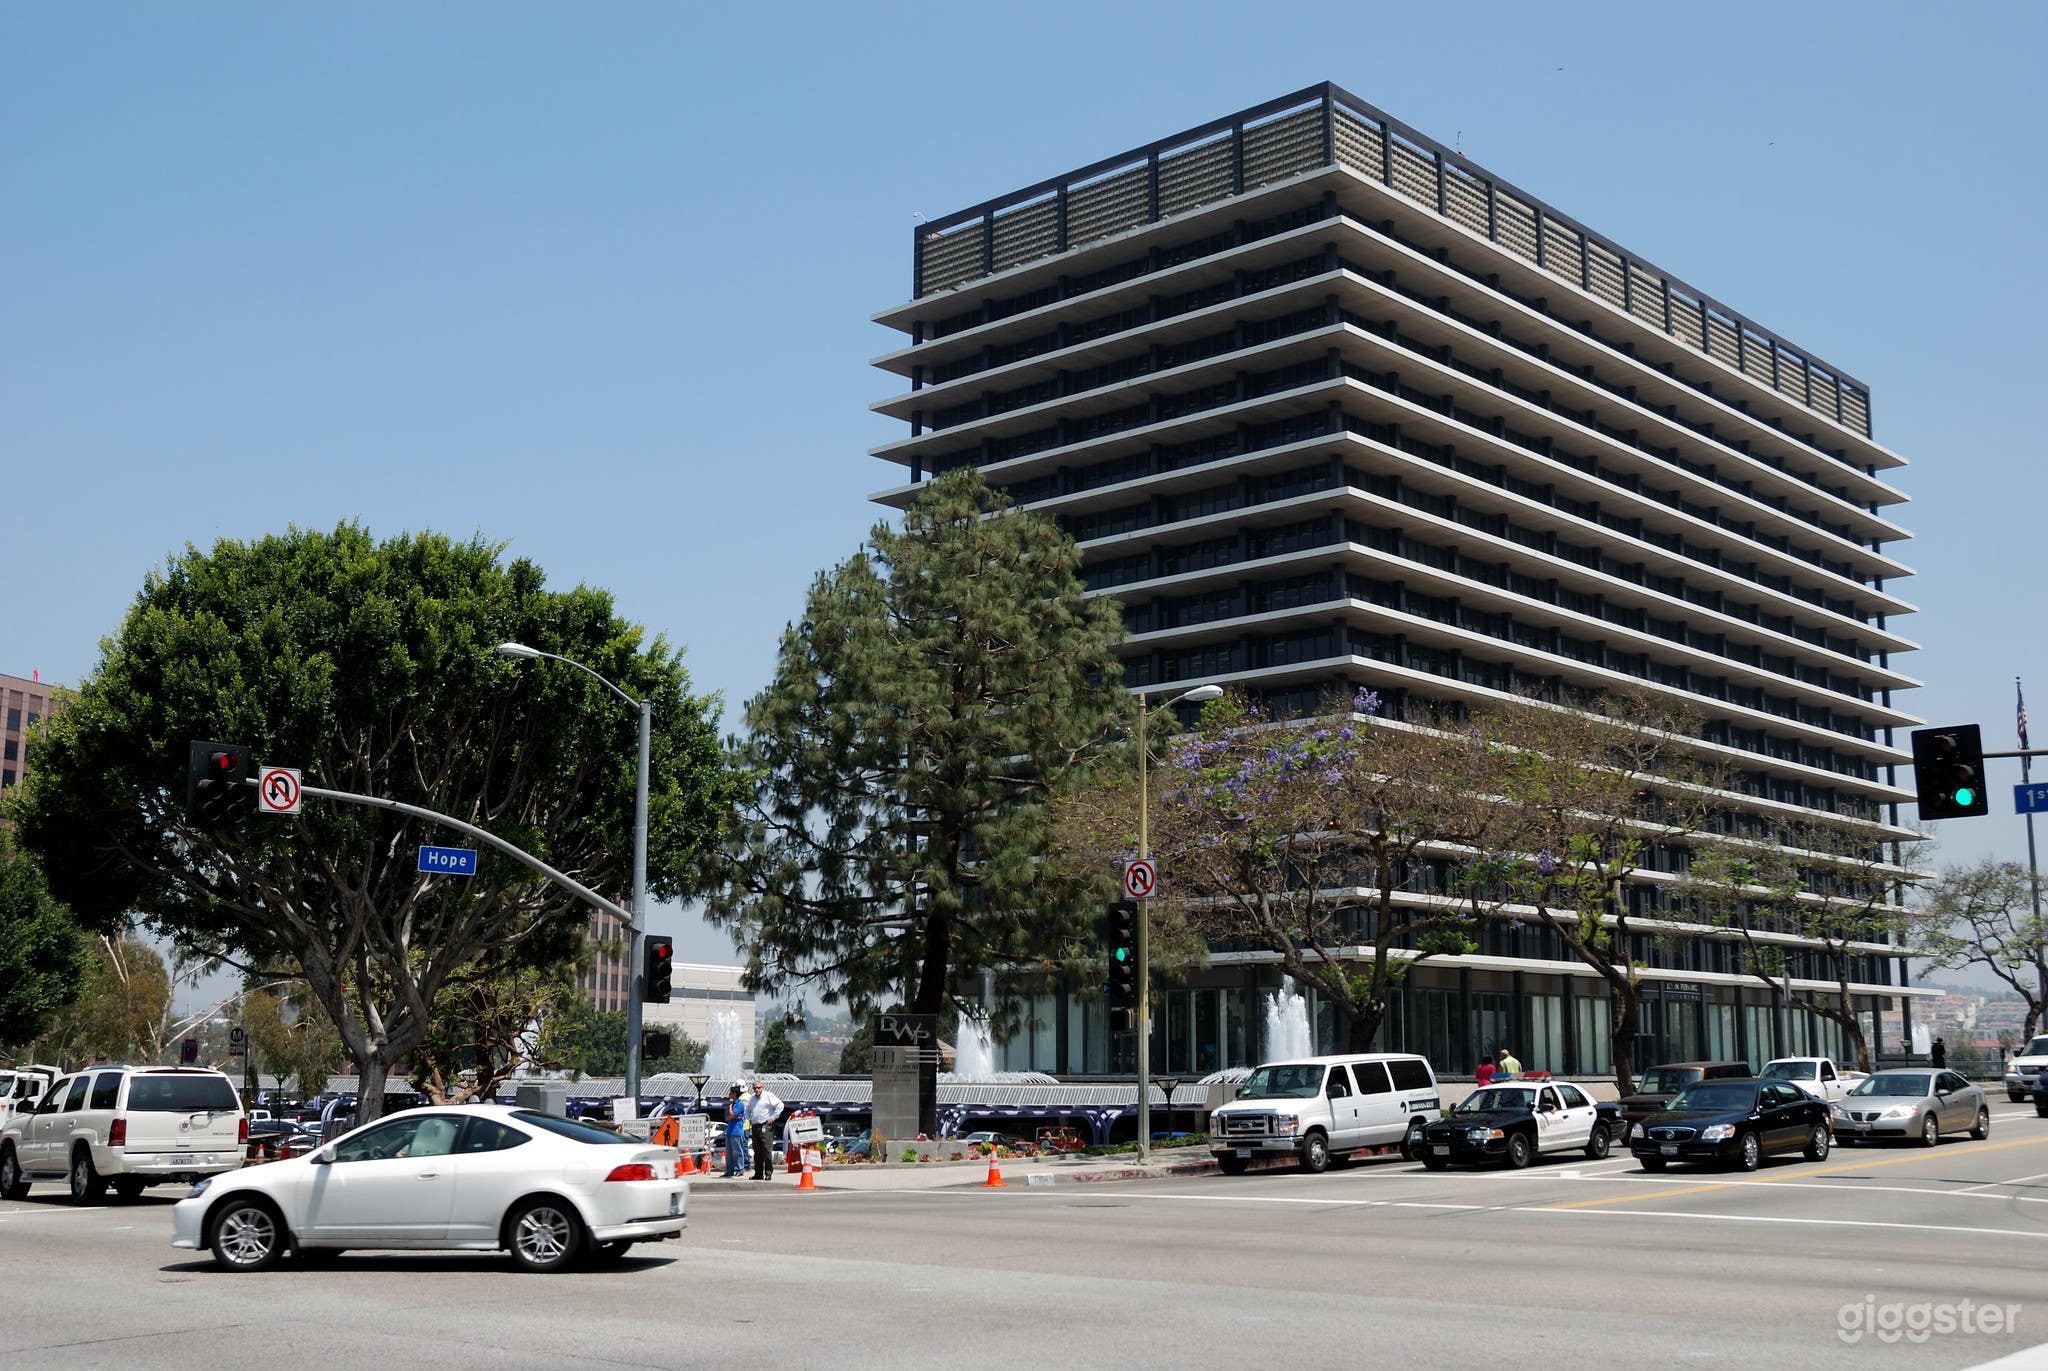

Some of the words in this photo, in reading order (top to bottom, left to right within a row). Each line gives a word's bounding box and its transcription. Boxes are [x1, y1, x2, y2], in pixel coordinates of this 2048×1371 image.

[2026, 789, 2048, 808] 1s
[428, 851, 467, 868] Hope
[232, 1029, 242, 1041] M
